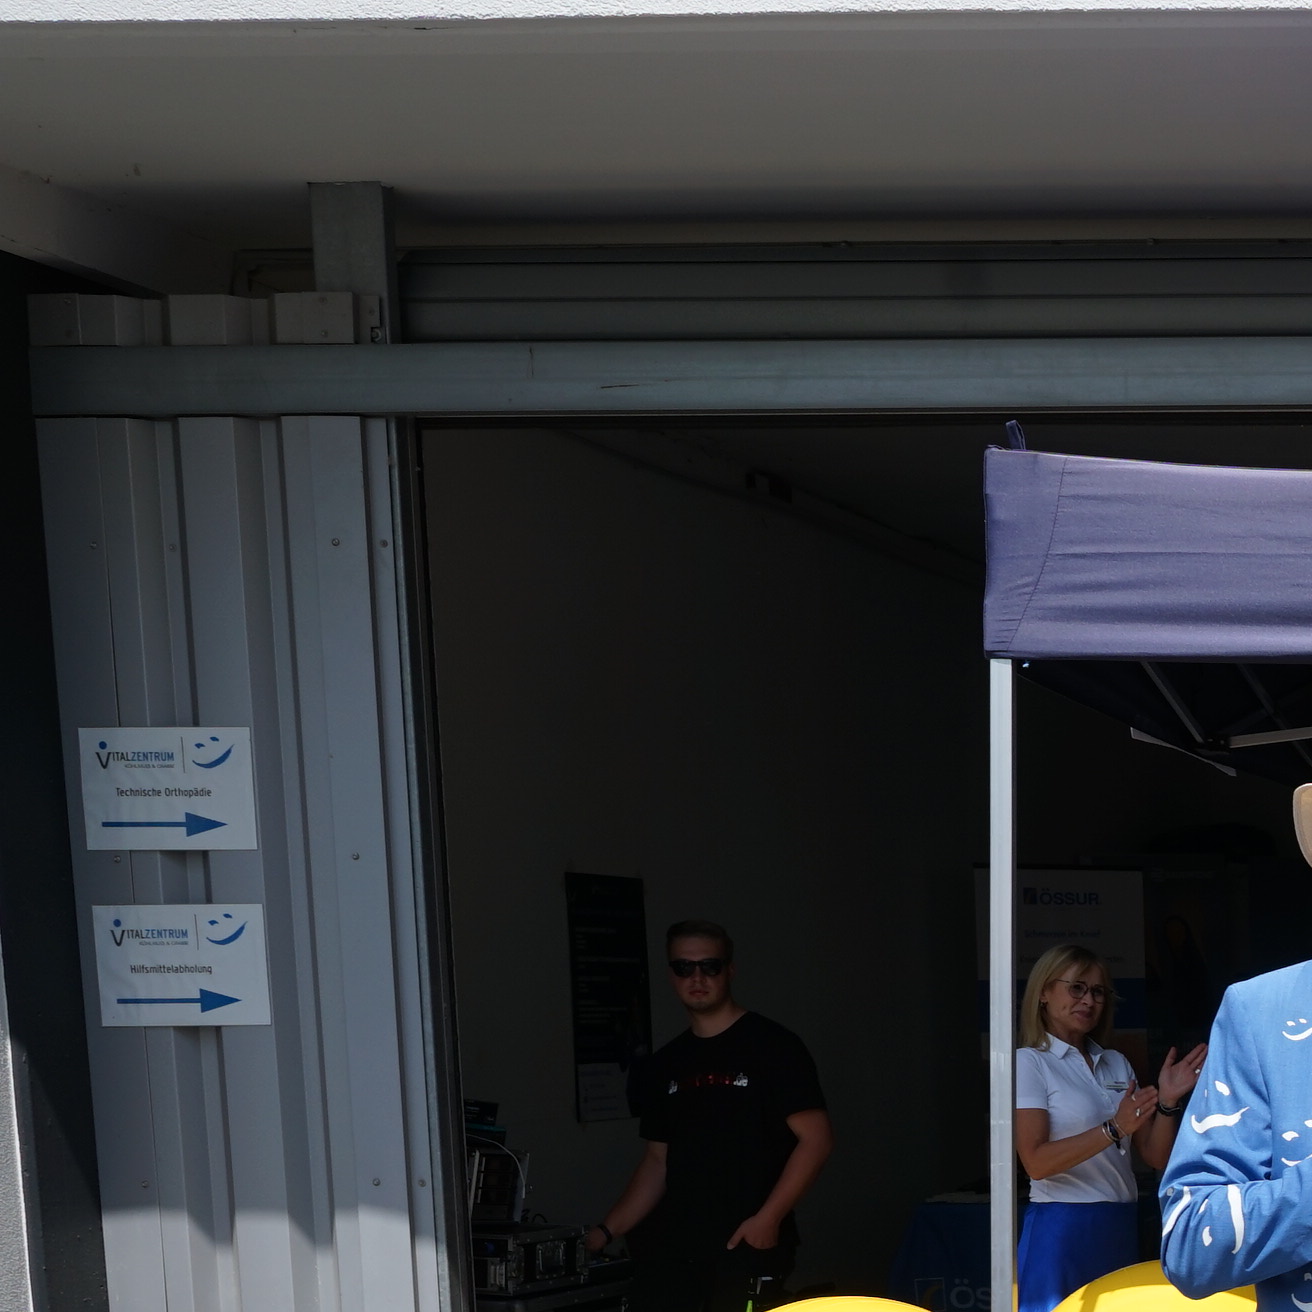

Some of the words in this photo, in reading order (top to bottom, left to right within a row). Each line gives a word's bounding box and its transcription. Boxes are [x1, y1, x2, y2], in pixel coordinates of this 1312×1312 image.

[96, 751, 174, 769] VITALZENTRUM
[115, 787, 162, 797] Technische
[165, 787, 212, 798] Orthopädie
[1040, 887, 1099, 905] ÖSSUR
[110, 929, 188, 947] VITALZENTRUM
[130, 964, 213, 975] Hilfsmittelabholung
